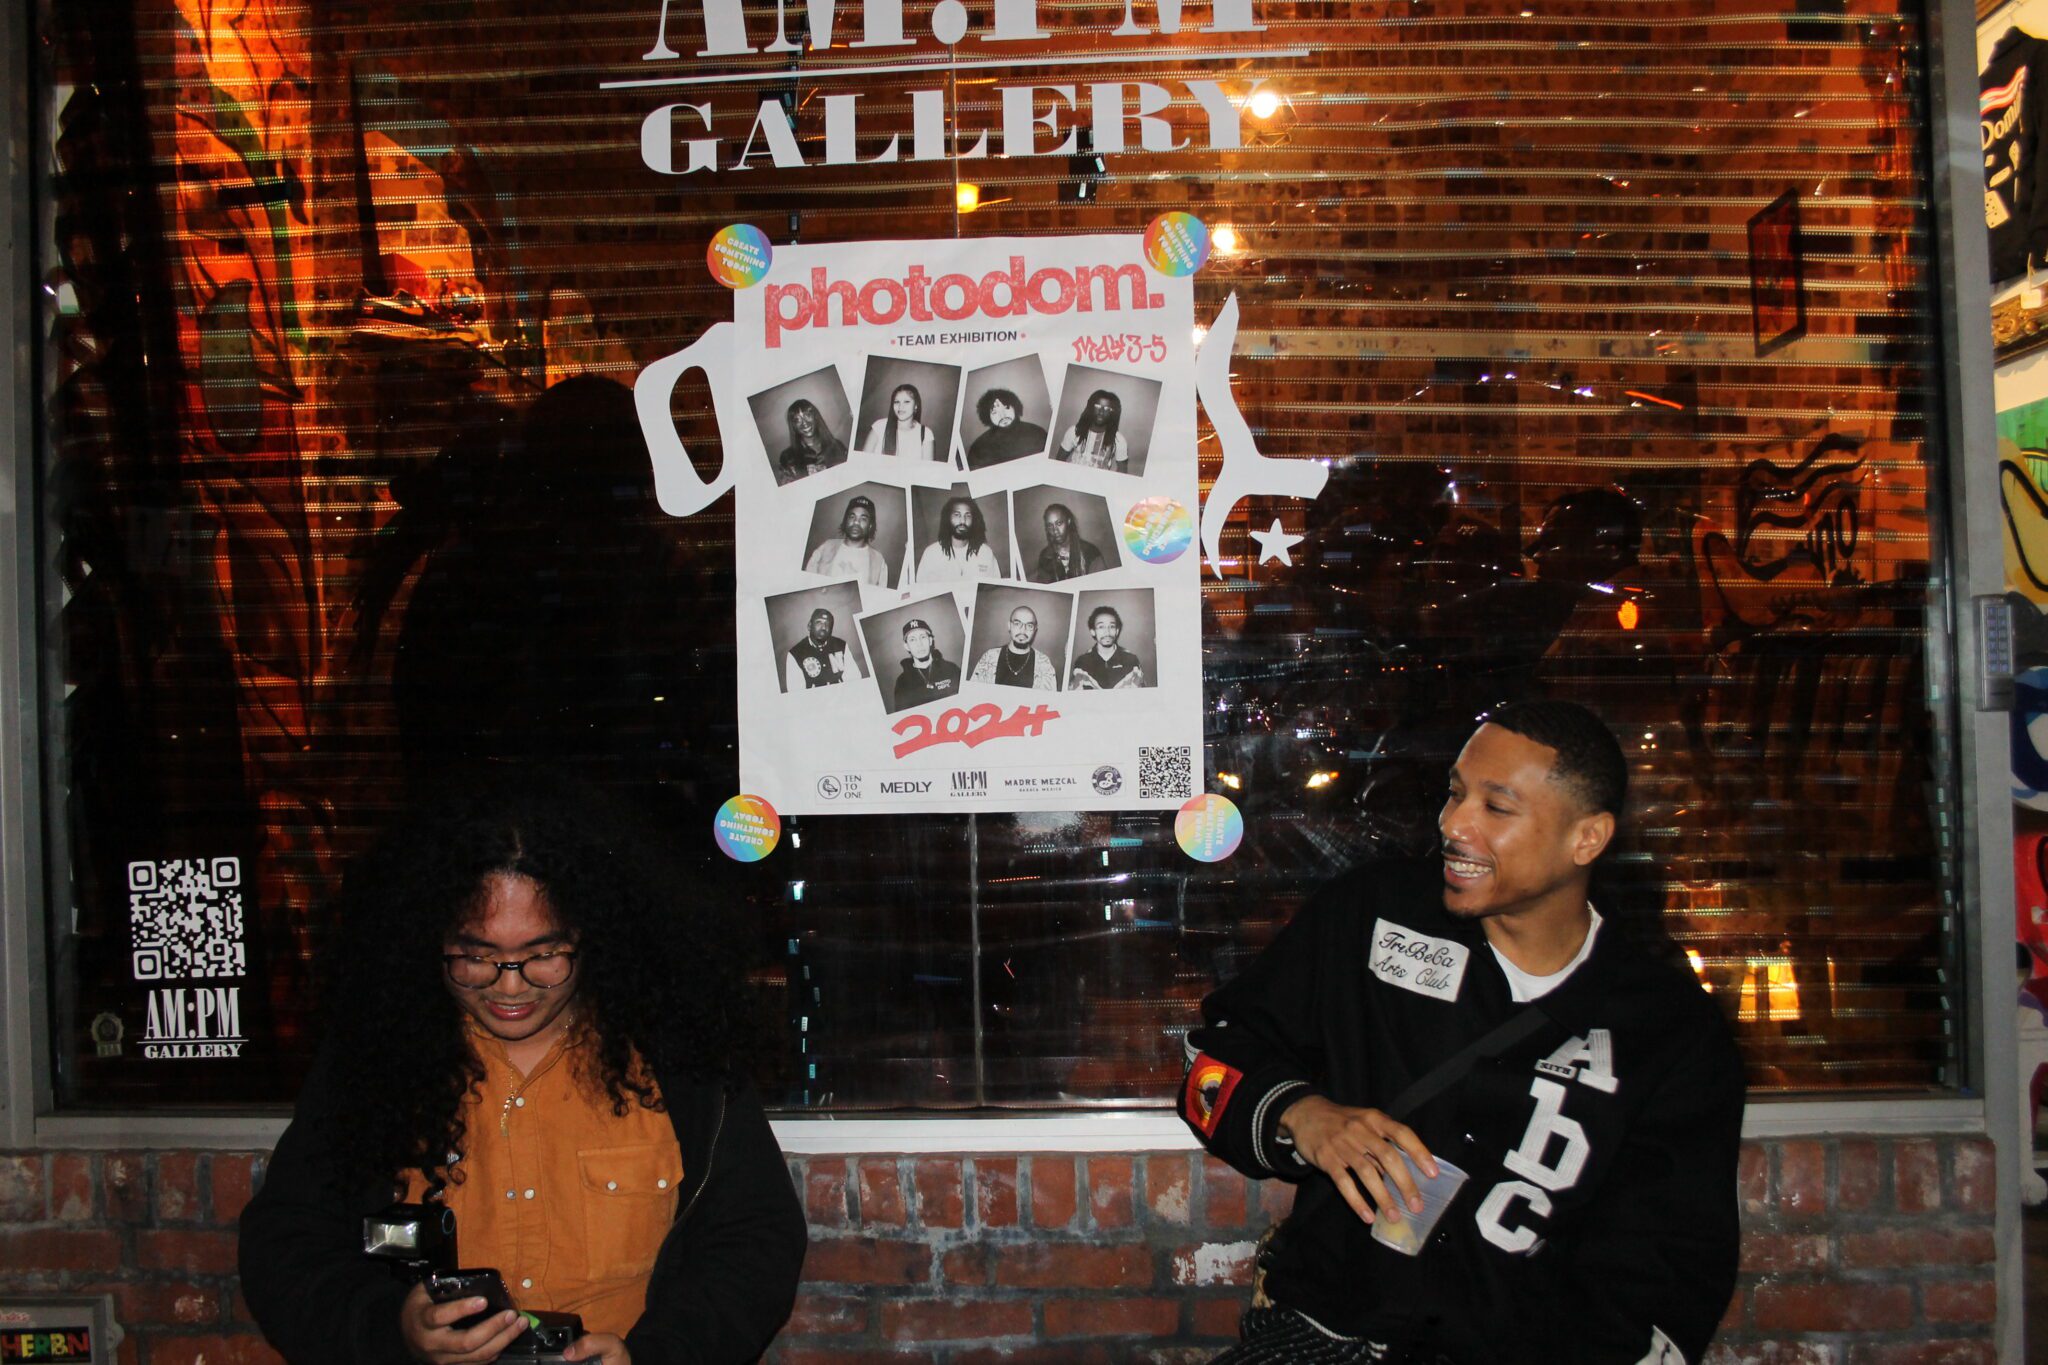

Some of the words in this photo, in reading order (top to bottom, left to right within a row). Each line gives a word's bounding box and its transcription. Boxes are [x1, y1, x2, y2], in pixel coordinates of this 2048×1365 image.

[640, 77, 1268, 175] GALLERY
[727, 237, 760, 256] CREATE
[1161, 219, 1194, 269] SOMETHING
[1175, 222, 1197, 254] CREATE
[714, 243, 766, 269] SOMETHING
[1158, 235, 1179, 263] TODAY
[722, 257, 751, 274] TODAY
[764, 255, 1166, 349] photodom.
[897, 333, 936, 347] TEAM
[940, 330, 1018, 345] EXHIBITION
[891, 703, 1061, 760] 2024
[844, 774, 862, 783] TEN
[844, 783, 858, 791] TO
[880, 781, 932, 794] MEDLY
[950, 770, 988, 790] AM:PM
[1004, 778, 1038, 787] MADRE
[1041, 777, 1077, 786] MEZCAL
[844, 791, 862, 799] ONE
[733, 812, 764, 825] TODAY
[720, 819, 775, 838] SOMETHING
[729, 832, 764, 846] CREATE
[1378, 931, 1457, 968] TriBeCa
[1375, 955, 1409, 978] Arts
[1415, 968, 1451, 990] Club
[144, 987, 242, 1039] AM:PM
[144, 1043, 242, 1059] GALLERY
